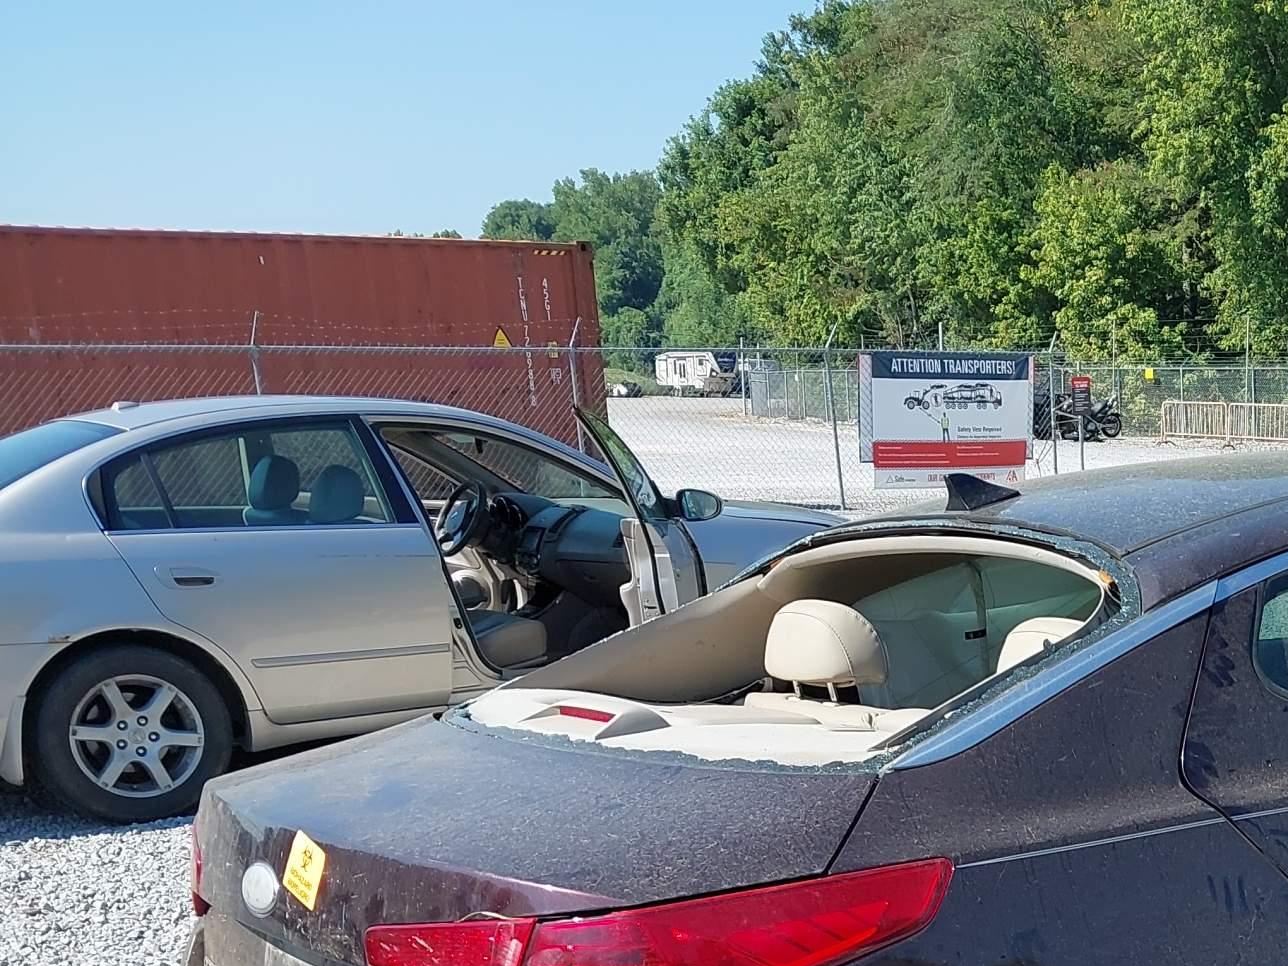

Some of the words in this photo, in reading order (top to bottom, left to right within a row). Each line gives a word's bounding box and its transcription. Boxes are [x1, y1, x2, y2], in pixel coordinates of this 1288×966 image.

[541, 277, 552, 321] 45G1
[891, 357, 941, 374] ATTENTION
[943, 359, 1016, 375] TRANSPORTERS!
